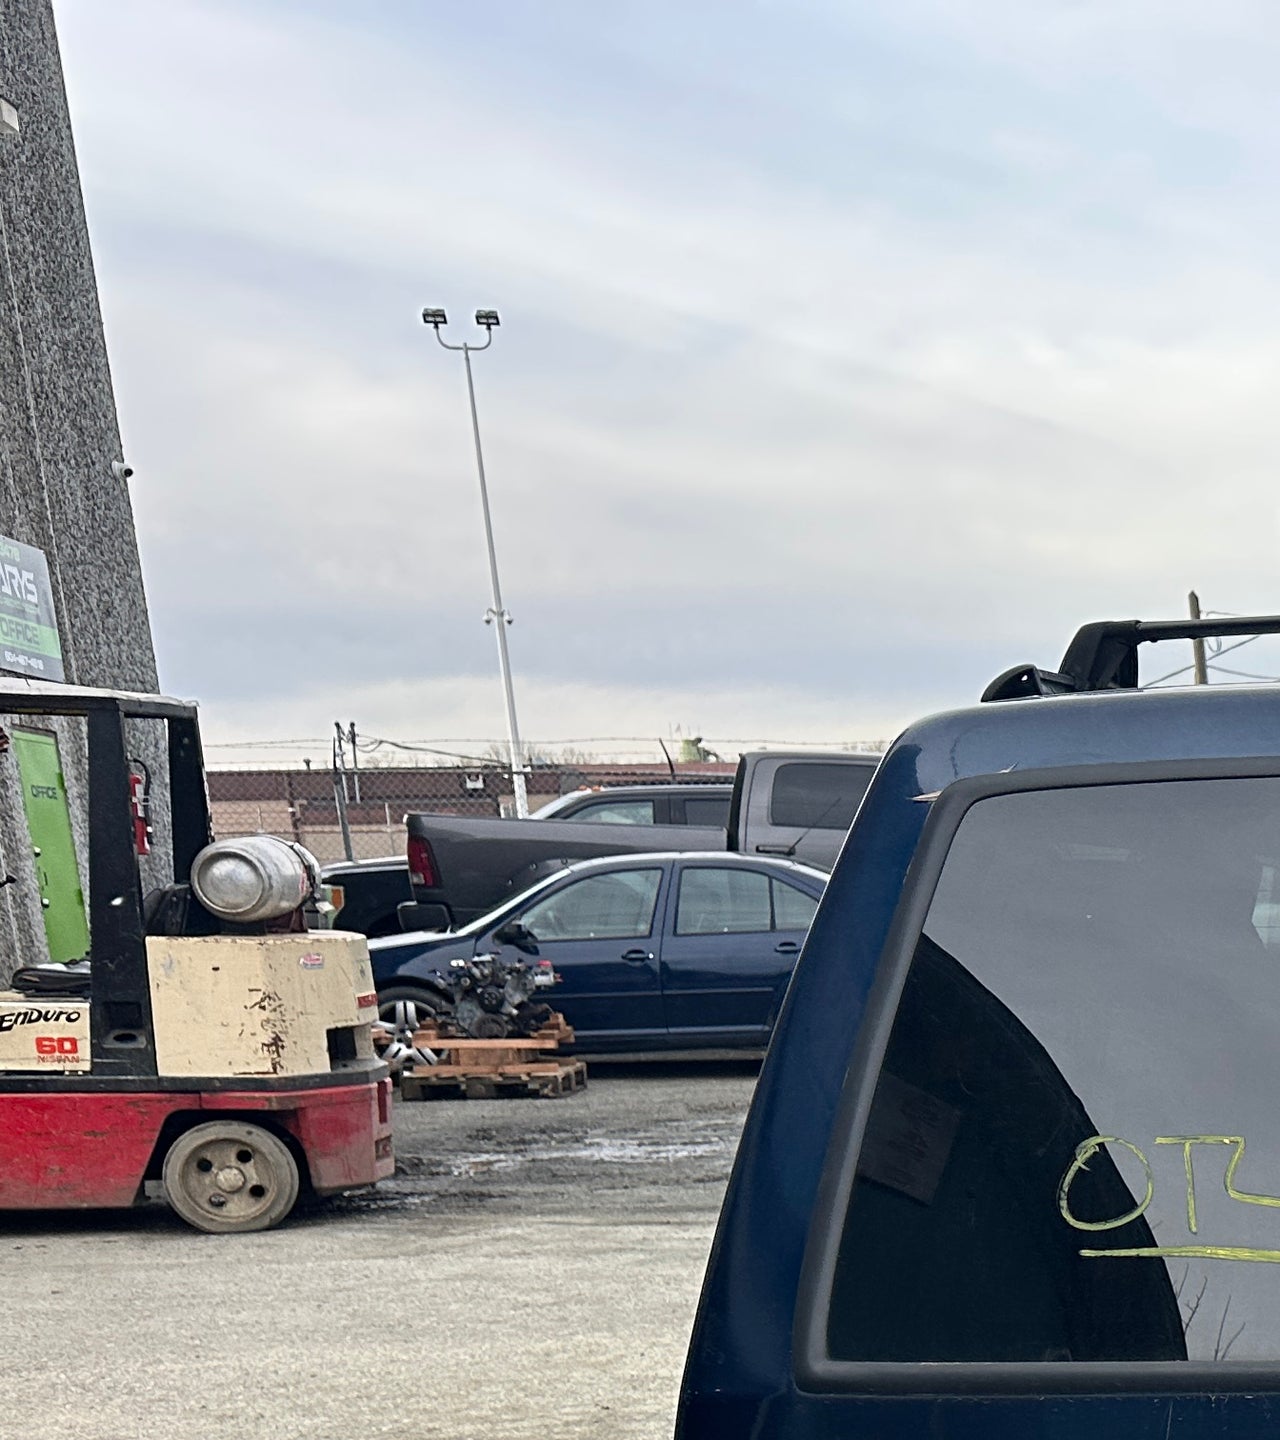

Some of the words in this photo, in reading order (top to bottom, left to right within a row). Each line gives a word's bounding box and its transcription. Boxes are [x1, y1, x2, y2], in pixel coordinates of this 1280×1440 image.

[0, 617, 40, 646] OFFICE
[31, 785, 58, 800] OFFICE
[35, 1036, 79, 1054] 60
